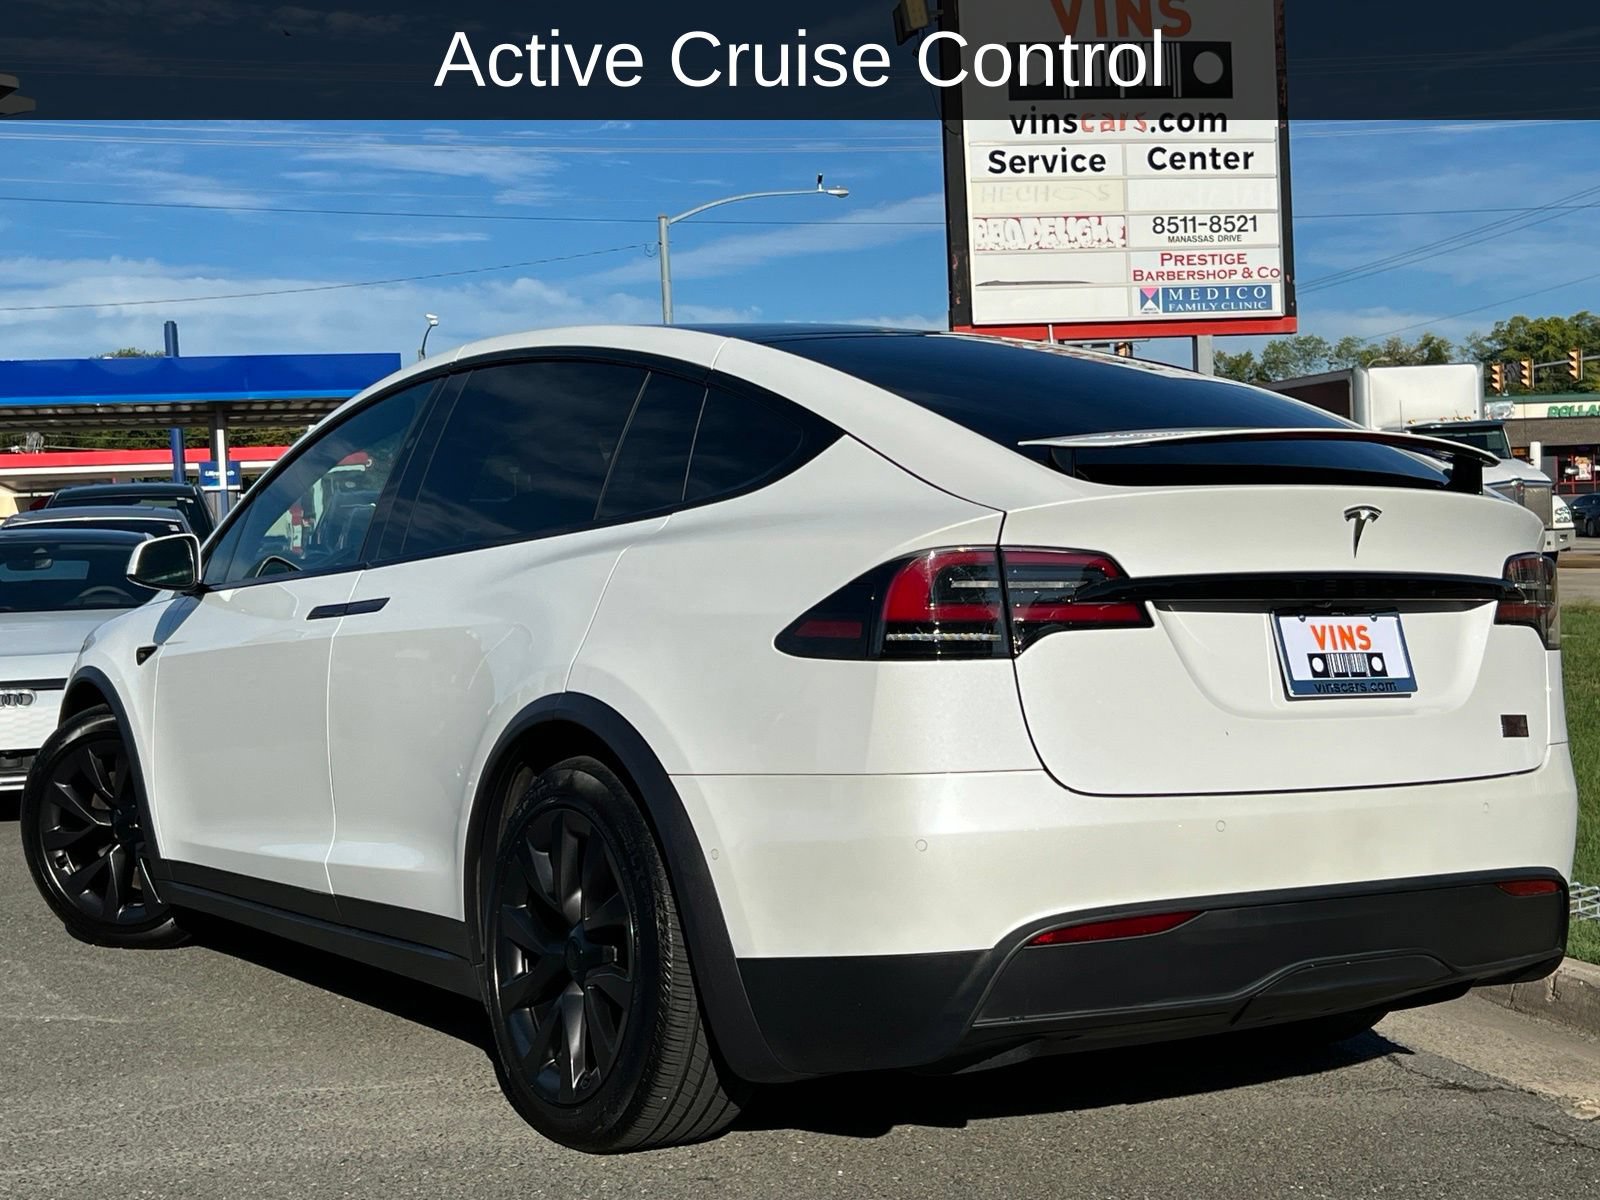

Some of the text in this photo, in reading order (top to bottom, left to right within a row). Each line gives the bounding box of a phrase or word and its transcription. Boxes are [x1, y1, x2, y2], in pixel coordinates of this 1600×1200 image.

[1050, 0, 1193, 38] VINS
[1009, 106, 1227, 135] vinscars.com
[987, 147, 1255, 174] Service Center
[1152, 215, 1258, 234] 8511-8521
[1167, 234, 1242, 243] MANASSAS DRIVE
[1160, 252, 1248, 266] PRESTIGE
[1133, 268, 1237, 282] BARBERSHOP
[1241, 267, 1253, 279] &
[1168, 286, 1266, 301] MEDICO
[1168, 302, 1218, 312] FAMILY
[1221, 301, 1267, 310] CLINIC
[1548, 404, 1600, 417] DOLLA
[1310, 625, 1372, 650] VINS
[1314, 681, 1397, 693] vinscars.com
